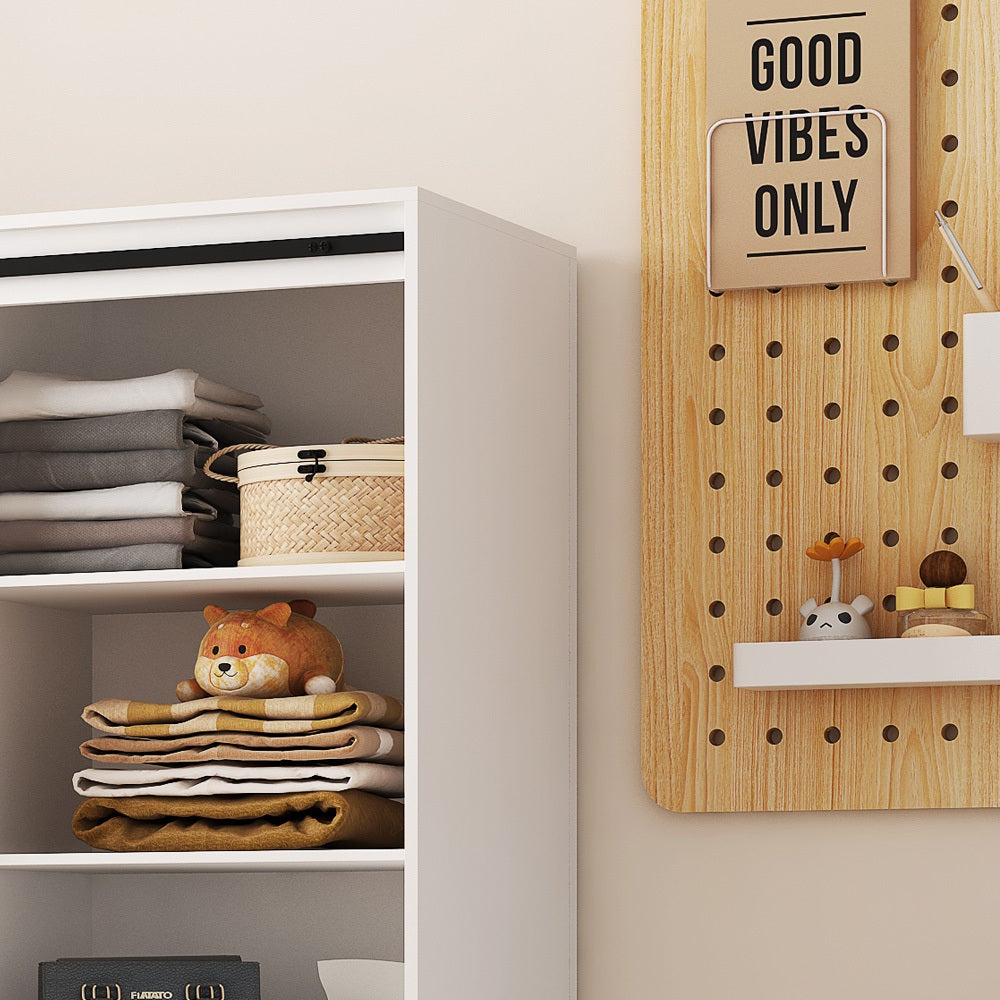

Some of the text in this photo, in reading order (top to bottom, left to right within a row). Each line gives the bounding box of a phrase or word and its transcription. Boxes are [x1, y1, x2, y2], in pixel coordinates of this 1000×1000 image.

[751, 31, 862, 92] GOOD
[744, 104, 869, 165] VIBES
[754, 178, 859, 238] ONLY
